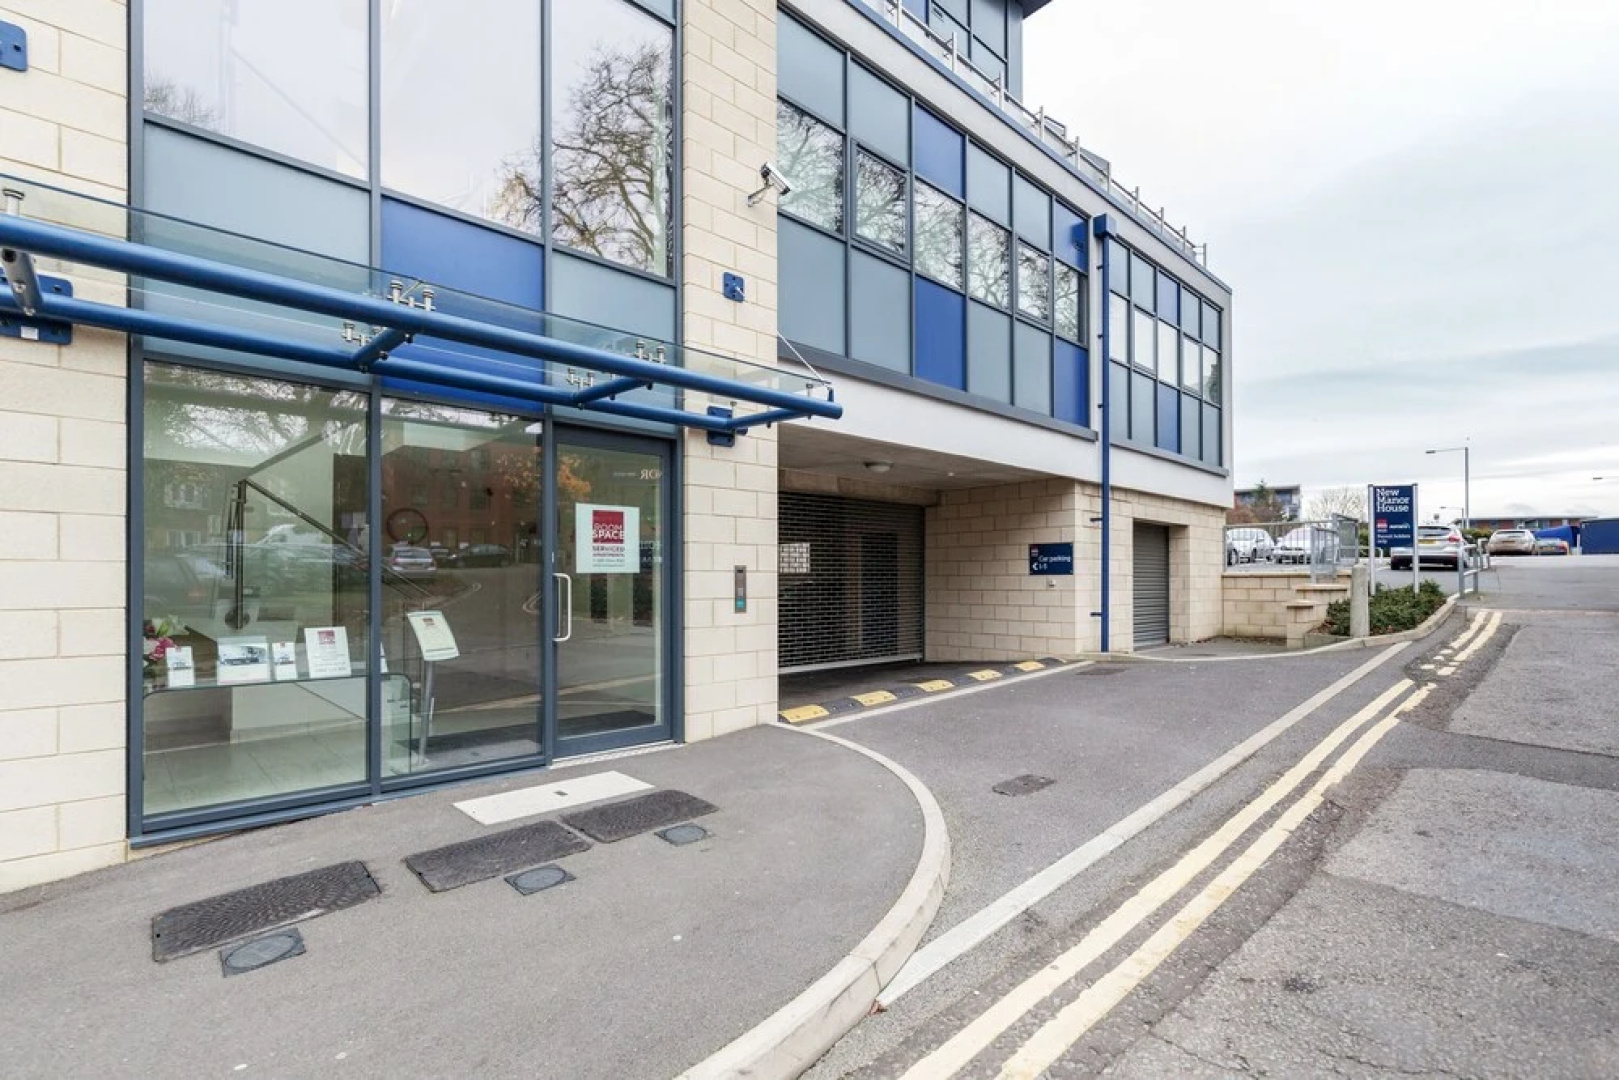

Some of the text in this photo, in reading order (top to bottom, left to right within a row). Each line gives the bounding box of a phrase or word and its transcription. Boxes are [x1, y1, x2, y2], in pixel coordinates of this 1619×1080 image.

[1376, 488, 1399, 496] New
[1376, 496, 1410, 504] Manor
[1376, 503, 1409, 512] House
[594, 522, 623, 531] ROOM
[592, 530, 625, 540] SPACE
[1049, 555, 1071, 563] parking
